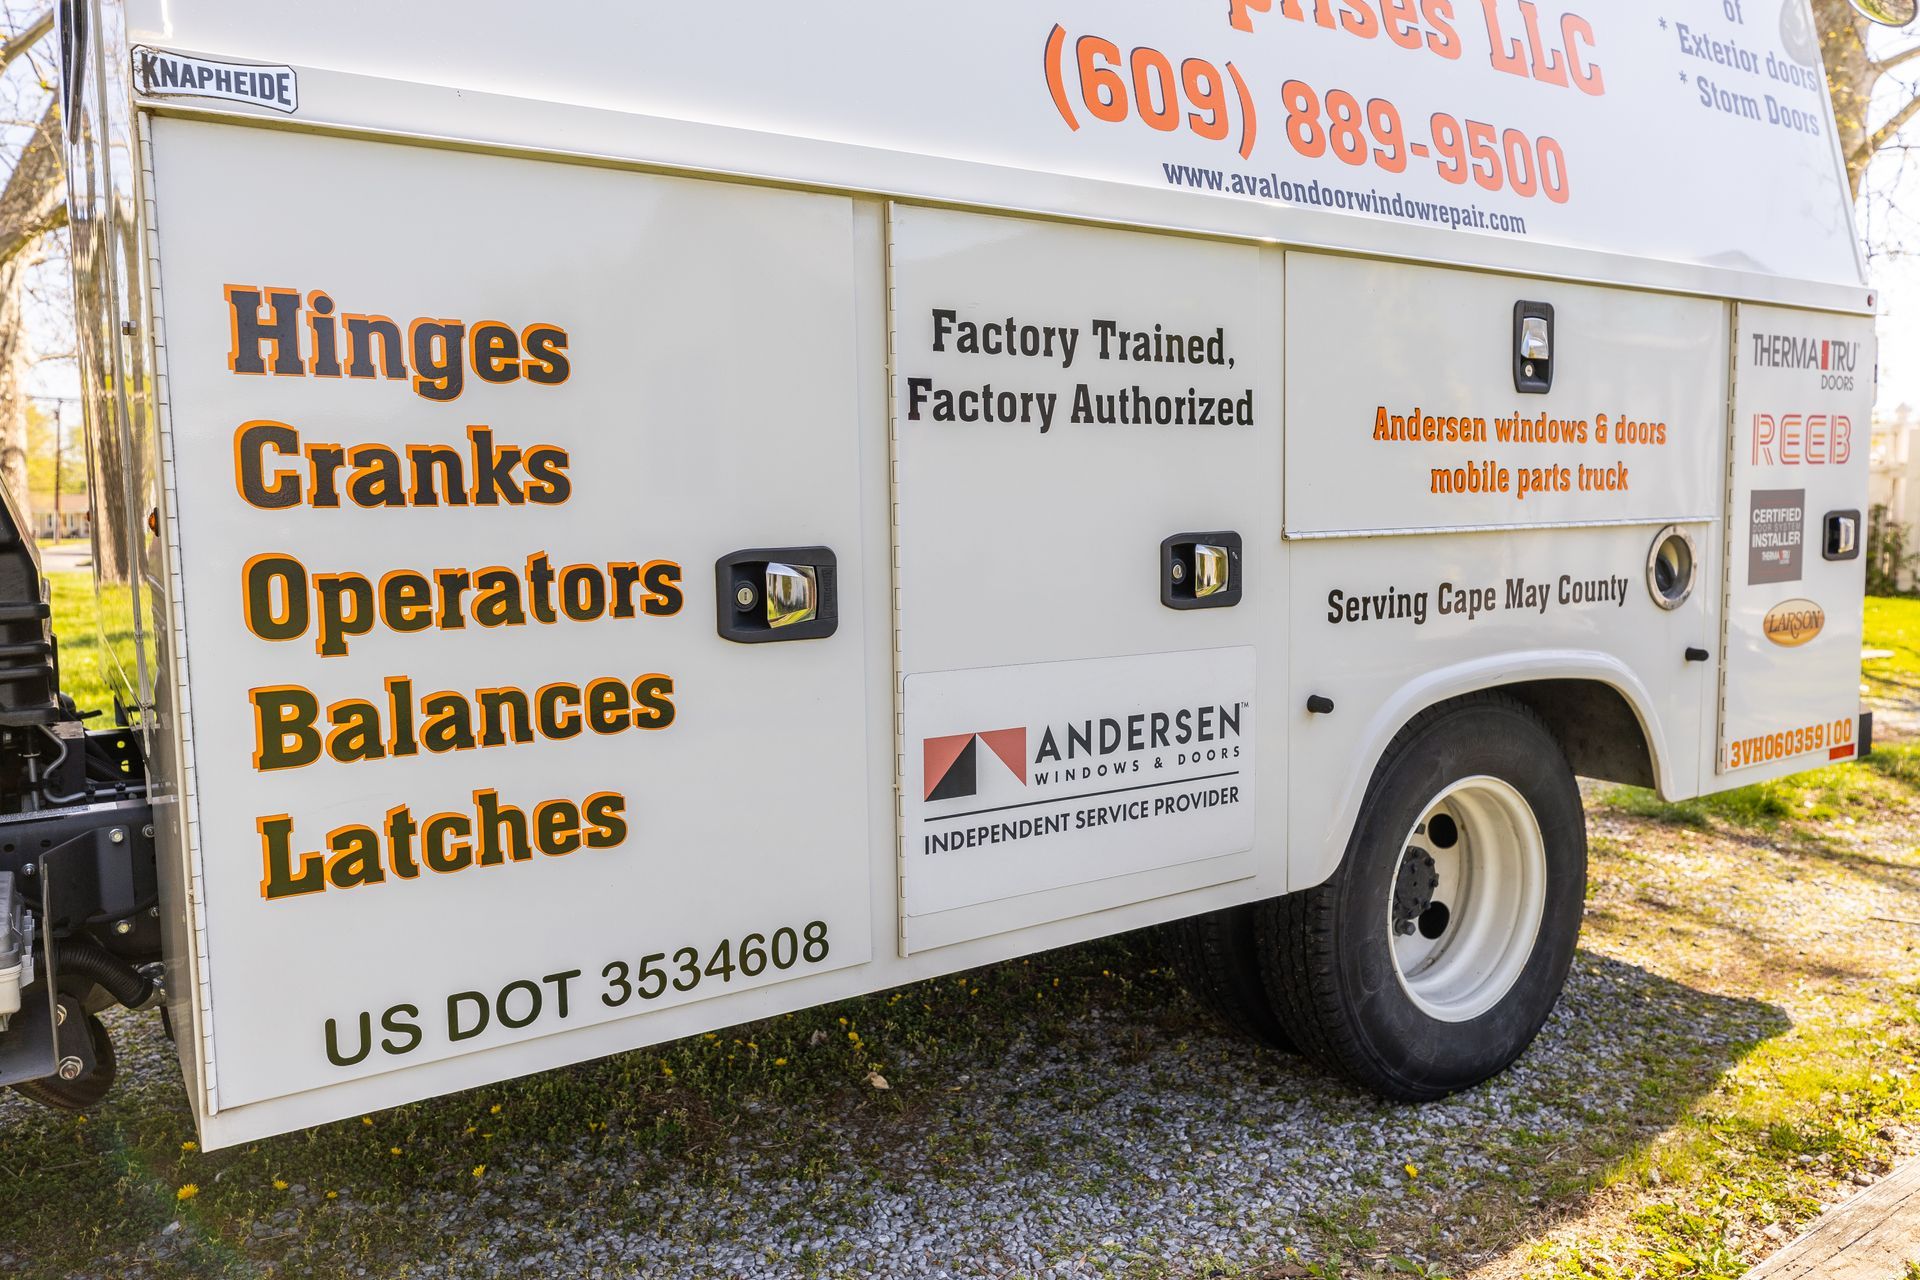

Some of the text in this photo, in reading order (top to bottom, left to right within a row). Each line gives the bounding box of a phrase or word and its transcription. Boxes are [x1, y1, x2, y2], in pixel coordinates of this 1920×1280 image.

[1723, 0, 1744, 25] of
[1480, 0, 1605, 96] LLC
[1676, 22, 1817, 92] Exterior doors
[142, 52, 291, 106] KNAPHEIDE
[1696, 75, 1820, 136] Storm Doors
[1043, 23, 1569, 204] (609) 889-9500
[1162, 162, 1526, 234] www.avalondoorwindowrepair.com
[224, 283, 571, 402] Hinges
[932, 308, 1235, 370] Factory Trained,
[907, 377, 1254, 434] Factory Authorized
[1821, 374, 1853, 391] DOORS
[1373, 406, 1666, 445] Andersen windows & doors
[1752, 414, 1851, 466] REEB
[233, 419, 572, 510] Cranks
[1431, 461, 1628, 499] mobile parts truck
[1752, 531, 1801, 548] INSTALLER
[1753, 507, 1802, 524] CERTIFIED
[242, 550, 684, 658] Operators
[1327, 574, 1628, 625] Serving Cape May County
[1768, 610, 1821, 639] LARSON
[248, 673, 676, 772] Balances
[1035, 702, 1240, 764] ANDERSEN
[1725, 718, 1852, 768] 3VH060359100
[1035, 746, 1240, 786] WINDOWS & DOORS
[256, 788, 628, 900] Latches
[924, 786, 1239, 855] INDEPENDENT SERVICE PROVIDER
[325, 920, 830, 1067] US DOT 3534608
